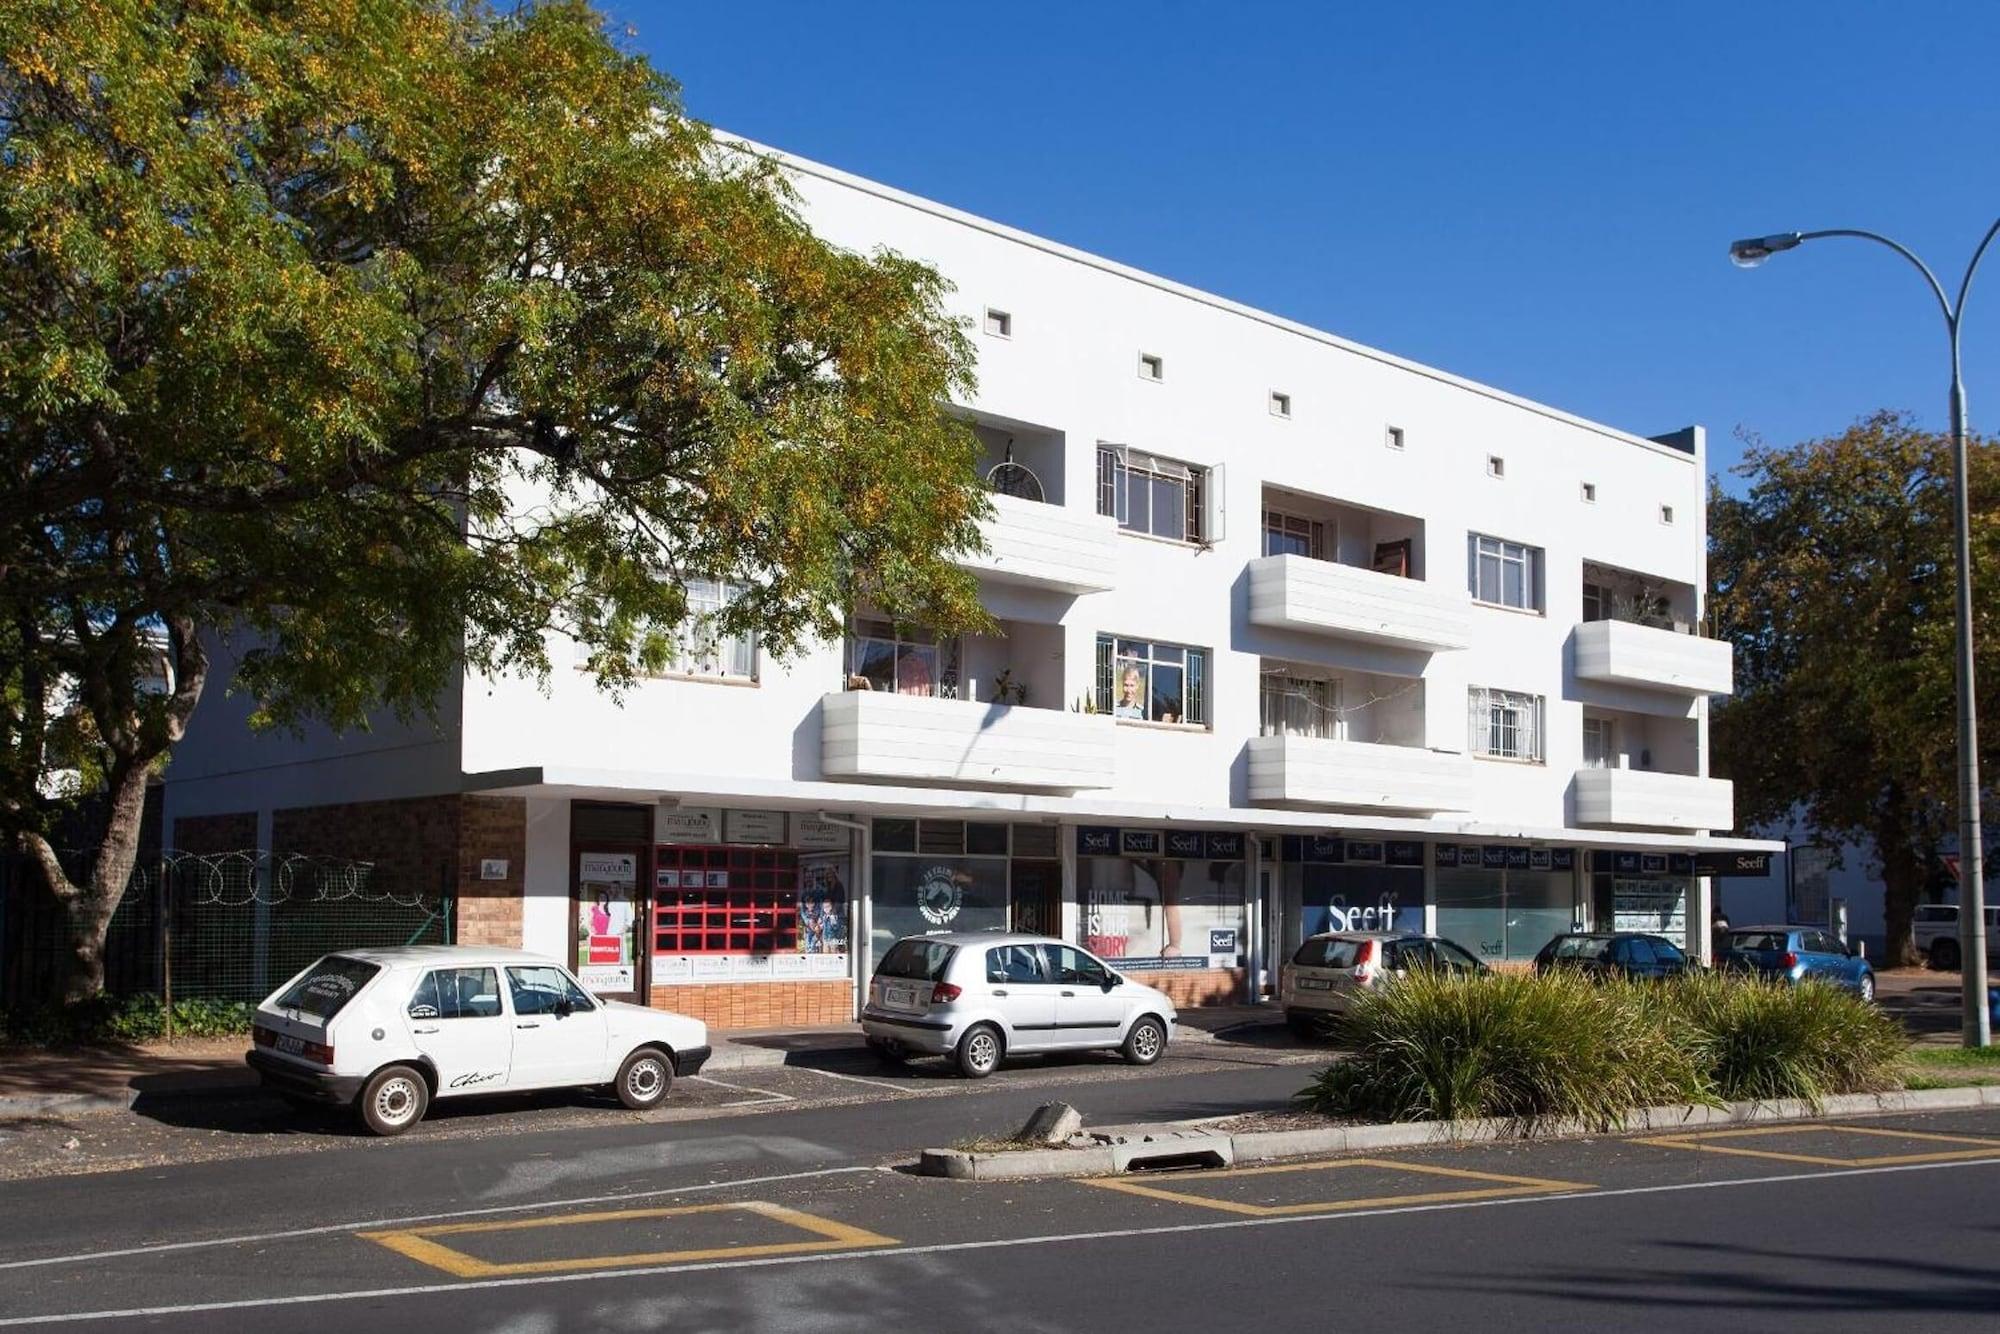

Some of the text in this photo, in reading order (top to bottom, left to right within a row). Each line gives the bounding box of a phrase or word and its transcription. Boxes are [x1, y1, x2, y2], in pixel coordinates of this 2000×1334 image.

[1085, 833, 1111, 848] Seeff
[1127, 834, 1153, 849] Seeff
[1172, 835, 1199, 850] Seeff
[1211, 836, 1237, 851] Seeff
[1736, 855, 1766, 870] Seeff
[1088, 890, 1129, 914] HOME
[1328, 891, 1399, 932] Seeff
[1088, 914, 1129, 936] IS OUR
[1088, 935, 1129, 957] STORY
[1212, 934, 1234, 947] Seeff
[1481, 940, 1503, 955] Seeff
[450, 1071, 503, 1088] Chico
